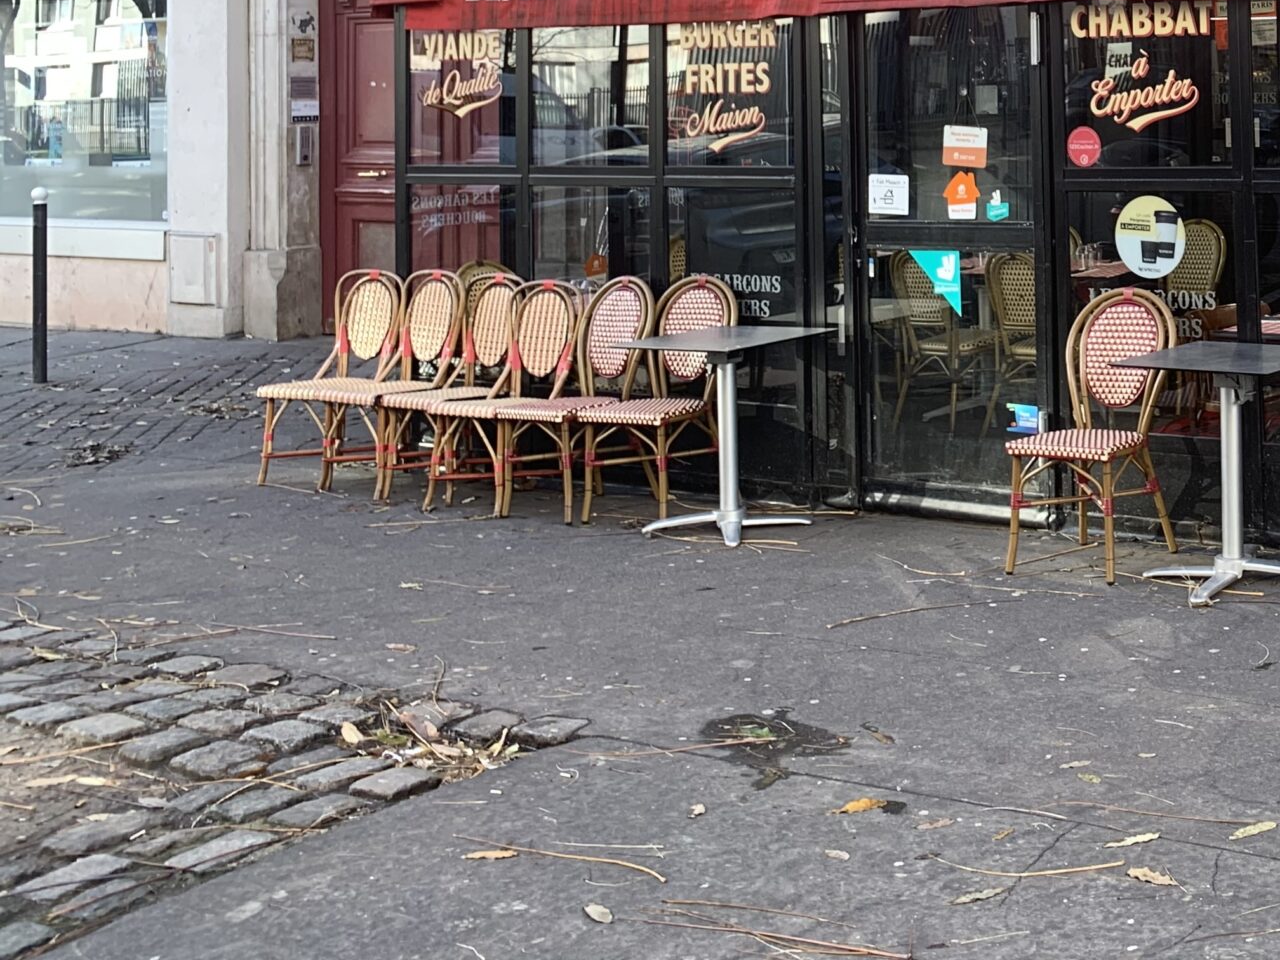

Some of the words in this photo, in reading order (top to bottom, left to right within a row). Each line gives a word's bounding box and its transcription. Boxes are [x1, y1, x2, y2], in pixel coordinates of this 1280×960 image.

[680, 19, 776, 49] BURGER
[1070, 0, 1212, 38] CHABBAT
[423, 31, 502, 61] VIANDE
[685, 62, 771, 95] FRITES
[1131, 48, 1150, 79] à
[423, 80, 440, 106] de
[1090, 69, 1197, 124] Emporter
[687, 98, 764, 137] Maison
